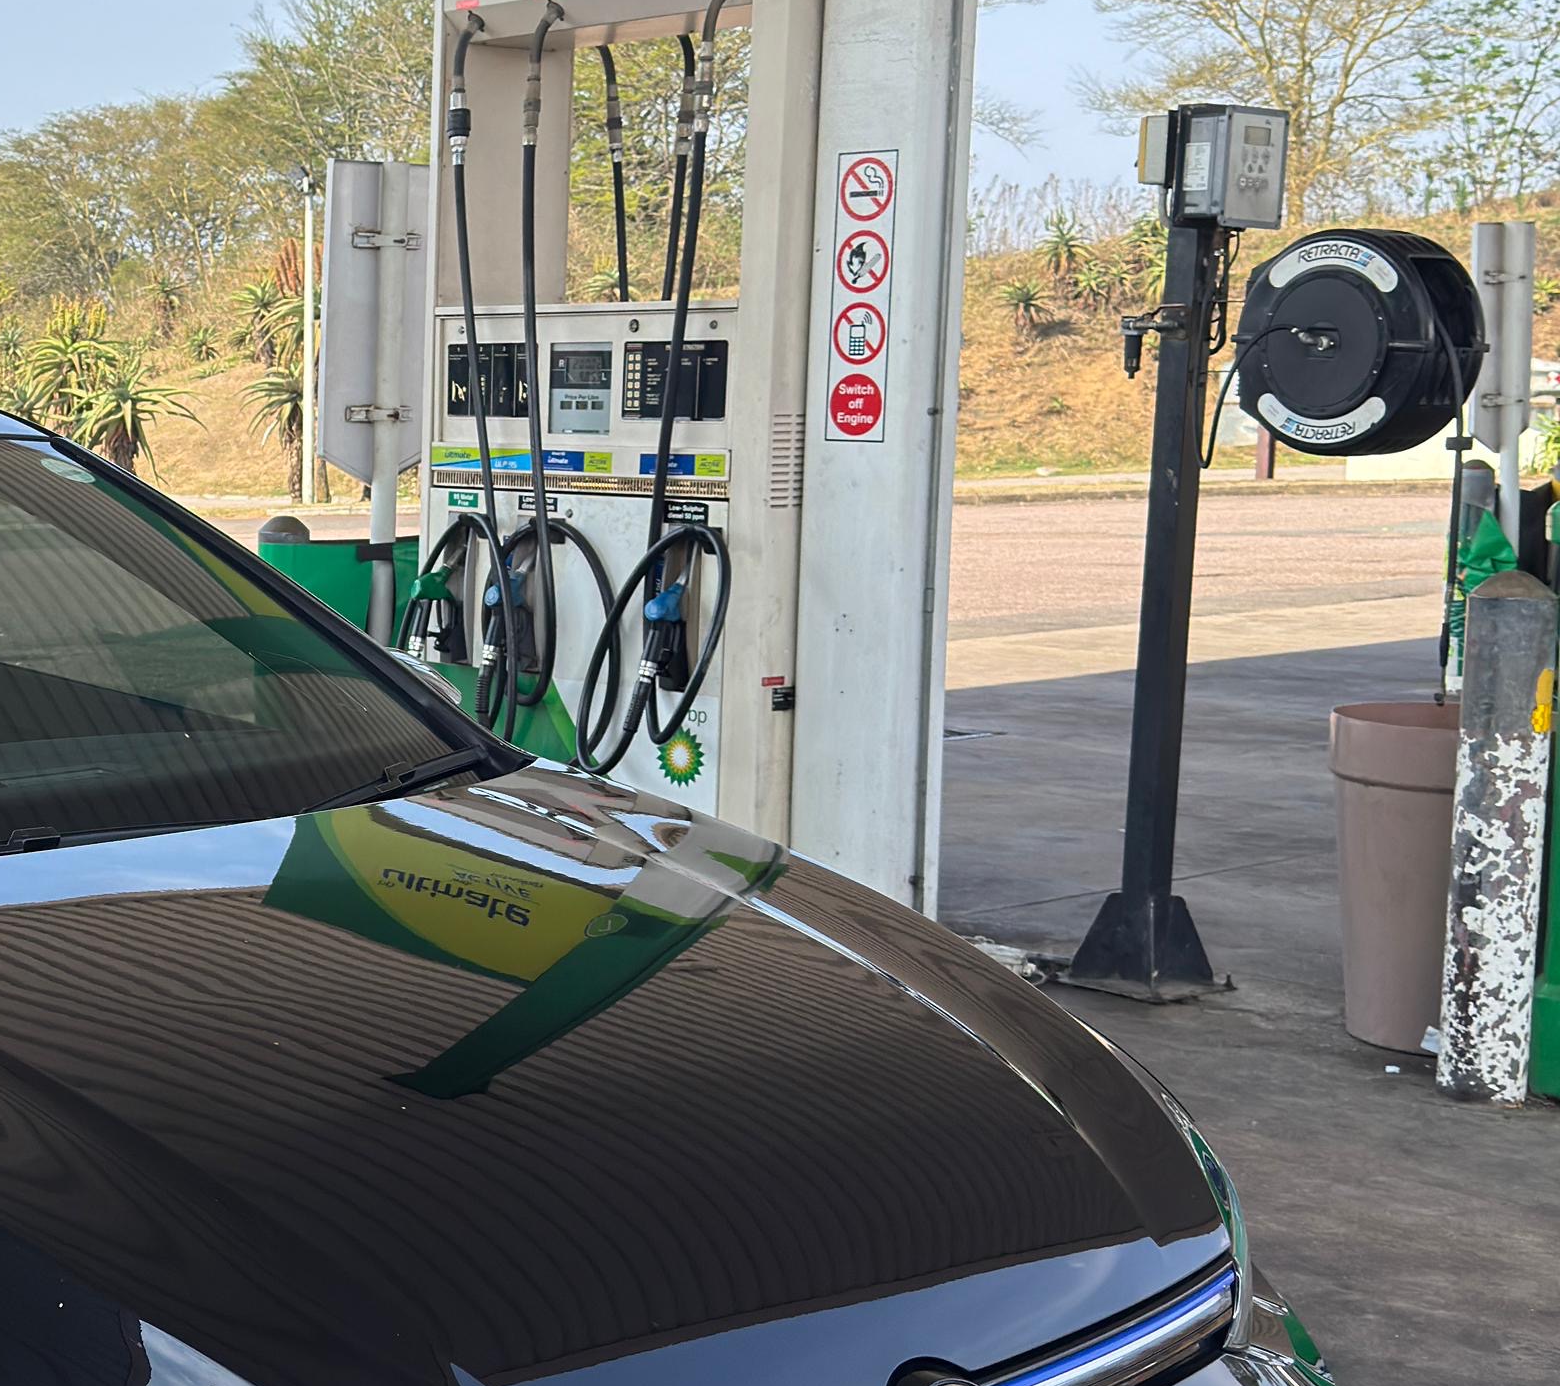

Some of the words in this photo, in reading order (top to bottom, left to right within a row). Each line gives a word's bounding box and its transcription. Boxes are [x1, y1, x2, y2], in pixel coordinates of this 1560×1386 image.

[1297, 243, 1361, 264] RETRACTA
[558, 358, 565, 368] R
[601, 372, 608, 381] L
[838, 383, 875, 395] Switch
[848, 398, 864, 409] off
[836, 412, 874, 426] Engine
[668, 504, 705, 513] Low-Sulphur
